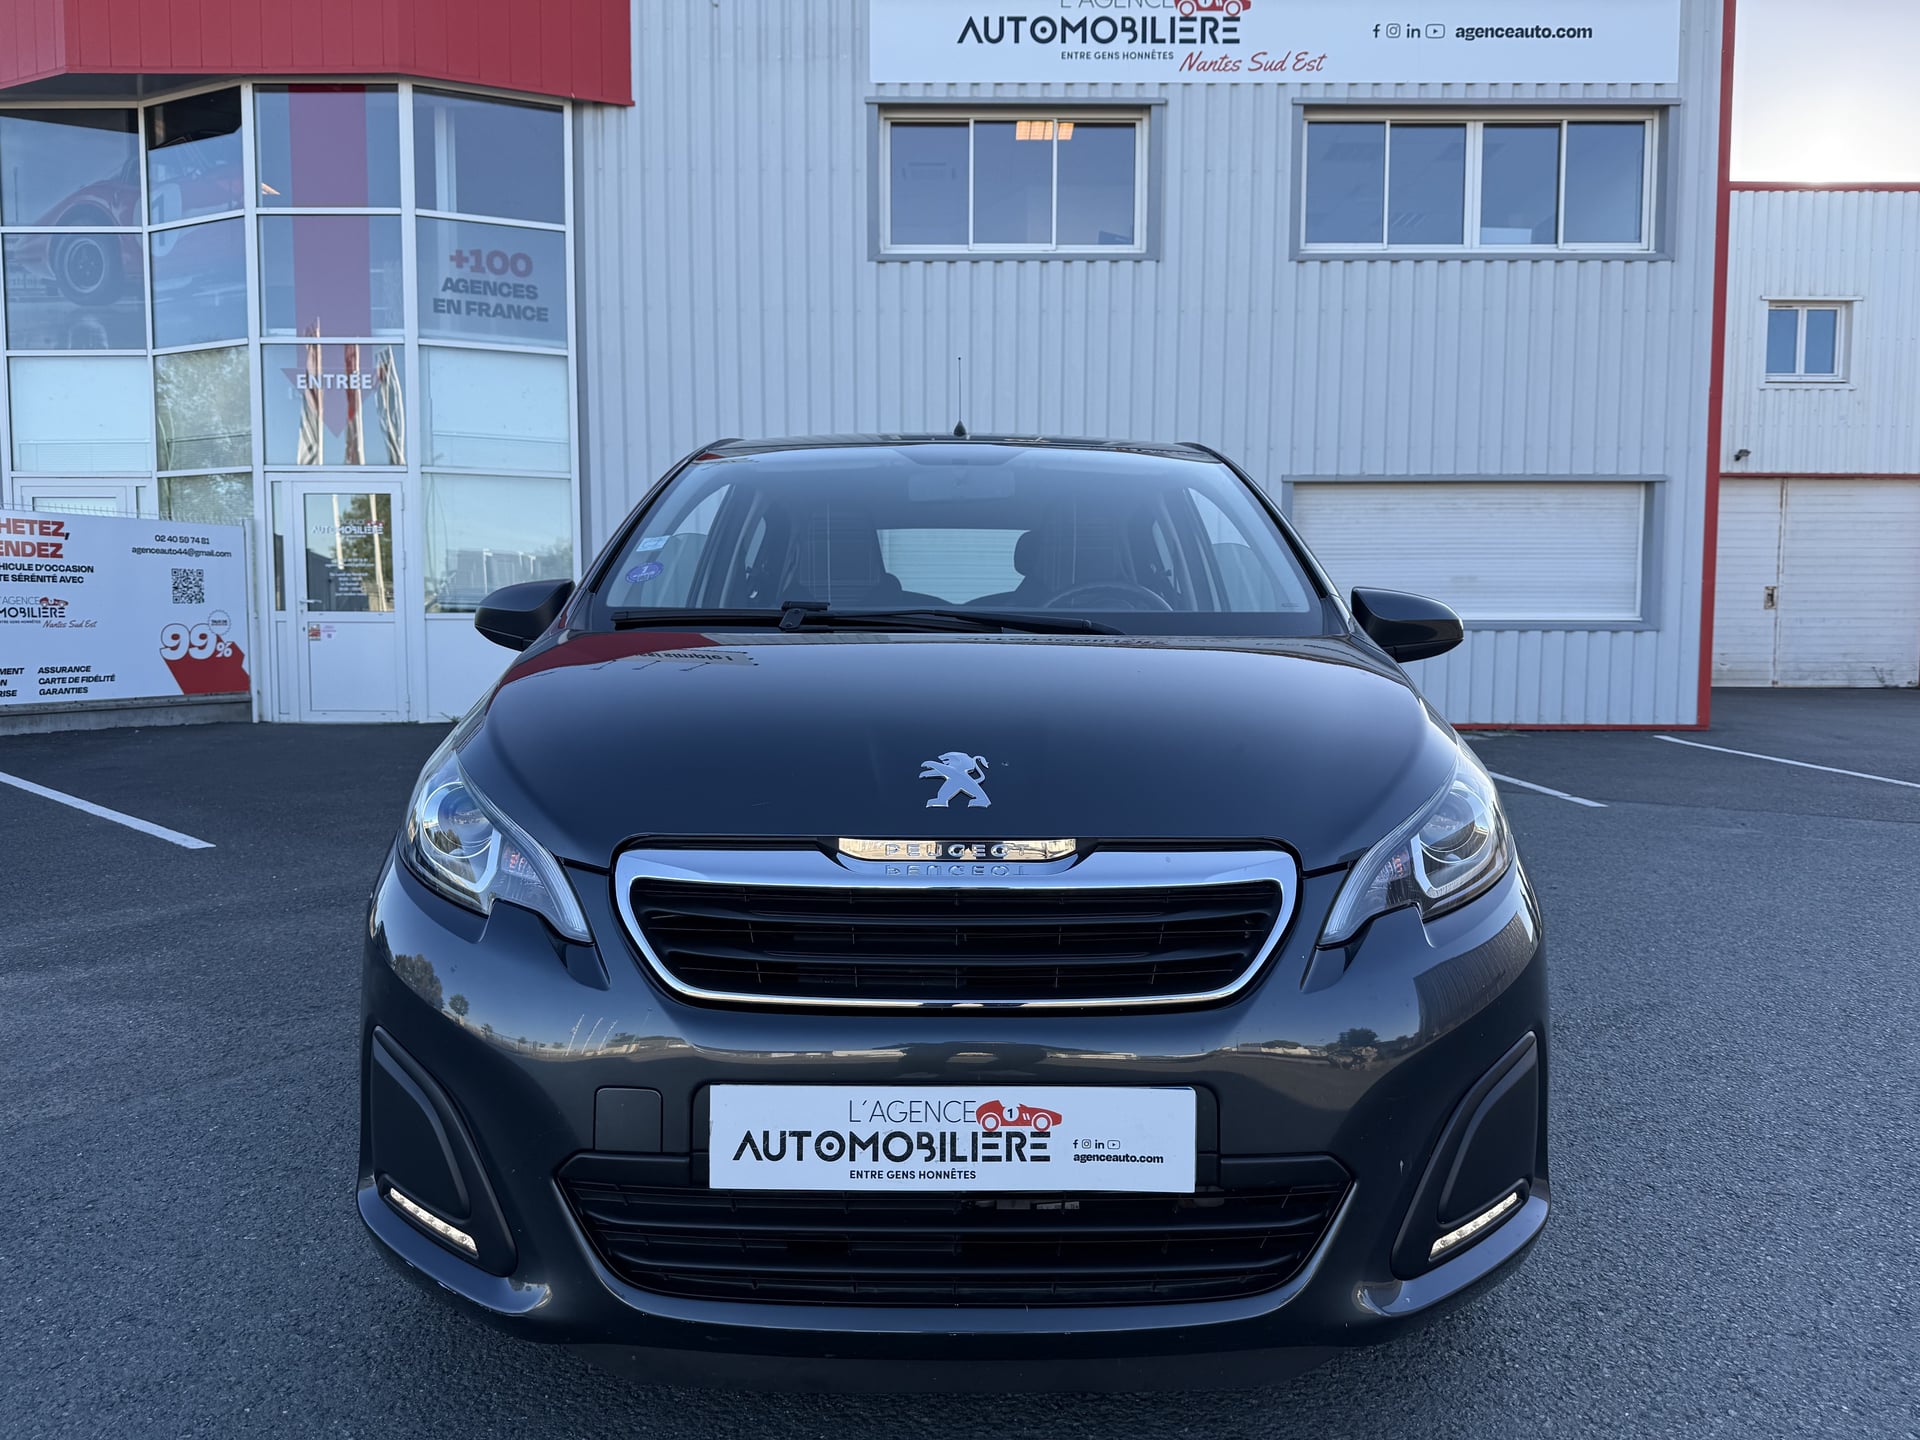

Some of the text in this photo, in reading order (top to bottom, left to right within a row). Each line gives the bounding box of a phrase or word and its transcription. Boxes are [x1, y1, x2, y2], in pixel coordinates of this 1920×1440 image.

[1455, 25, 1593, 41] agenceauto.com
[1061, 49, 1174, 60] ENTRE GENS HONNÊTES
[1179, 51, 1328, 72] Nantes Sud Est
[449, 249, 533, 278] +100
[441, 277, 539, 300] AGENCES
[433, 298, 549, 322] EN FRANCE
[296, 370, 372, 390] ENTRÉE
[154, 534, 166, 542] 02
[166, 535, 178, 543] 40
[35, 564, 94, 574] D'OCCASION
[10, 572, 58, 583] SÉRÉNITÉ
[59, 576, 84, 584] AVEC
[68, 619, 83, 628] Sud
[160, 623, 233, 662] 99%
[38, 666, 92, 674] ASSURANCE
[38, 677, 66, 685] CARTE
[81, 674, 116, 682] FIDÉLITÉ
[38, 686, 88, 696] GARANTIES
[885, 843, 1027, 857] PEUGEOT
[849, 1100, 977, 1124] L'AGENCE
[1073, 1153, 1164, 1164] agenceauto.com
[849, 1168, 976, 1180] ENTRE GENS HONNÊTES
